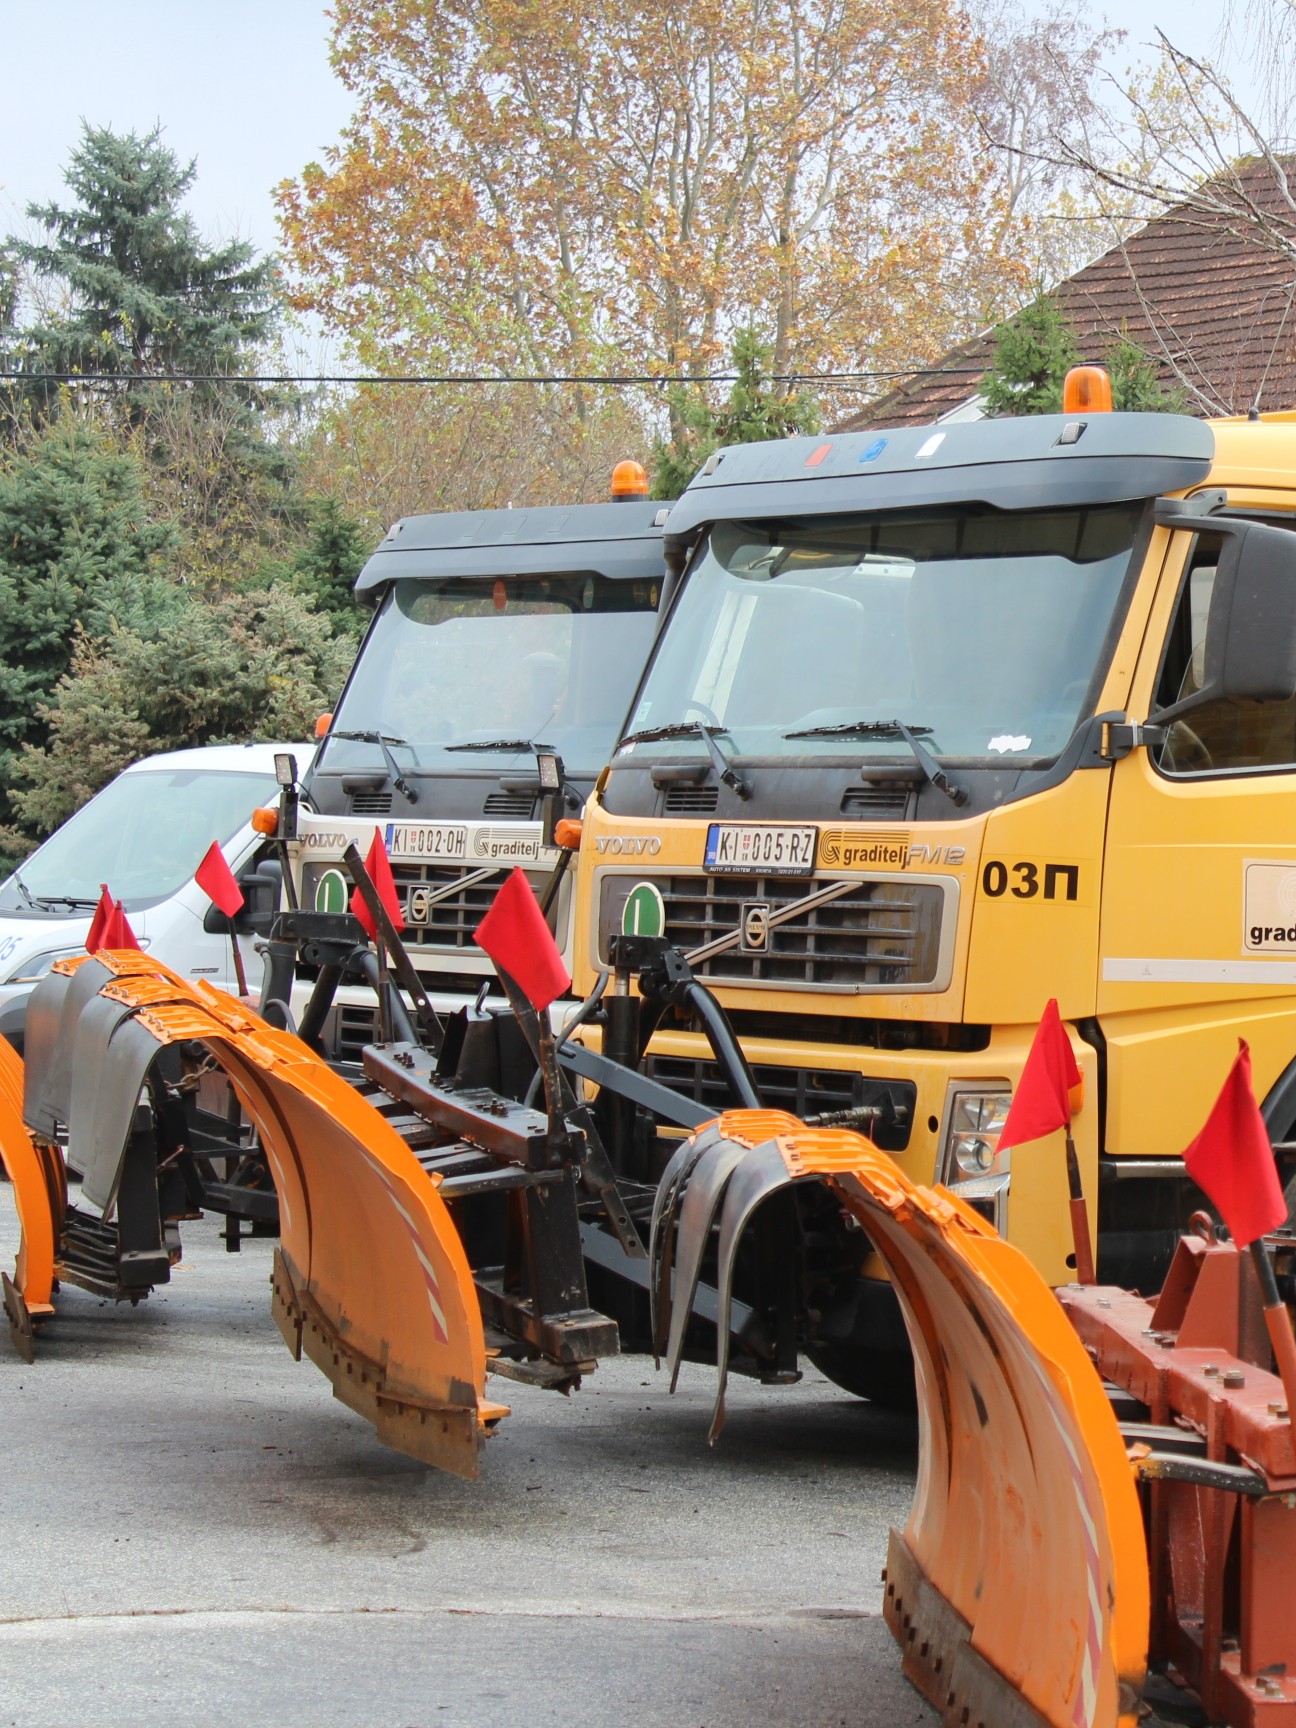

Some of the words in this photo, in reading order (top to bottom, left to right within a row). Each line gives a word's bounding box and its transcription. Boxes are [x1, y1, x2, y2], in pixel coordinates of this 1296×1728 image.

[297, 833, 348, 848] VOLVO
[393, 829, 408, 852] KI
[491, 841, 540, 860] graditelj
[595, 836, 662, 856] VOLVO
[719, 832, 739, 861] KI
[843, 845, 908, 870] graditelj
[906, 844, 966, 866] FM12
